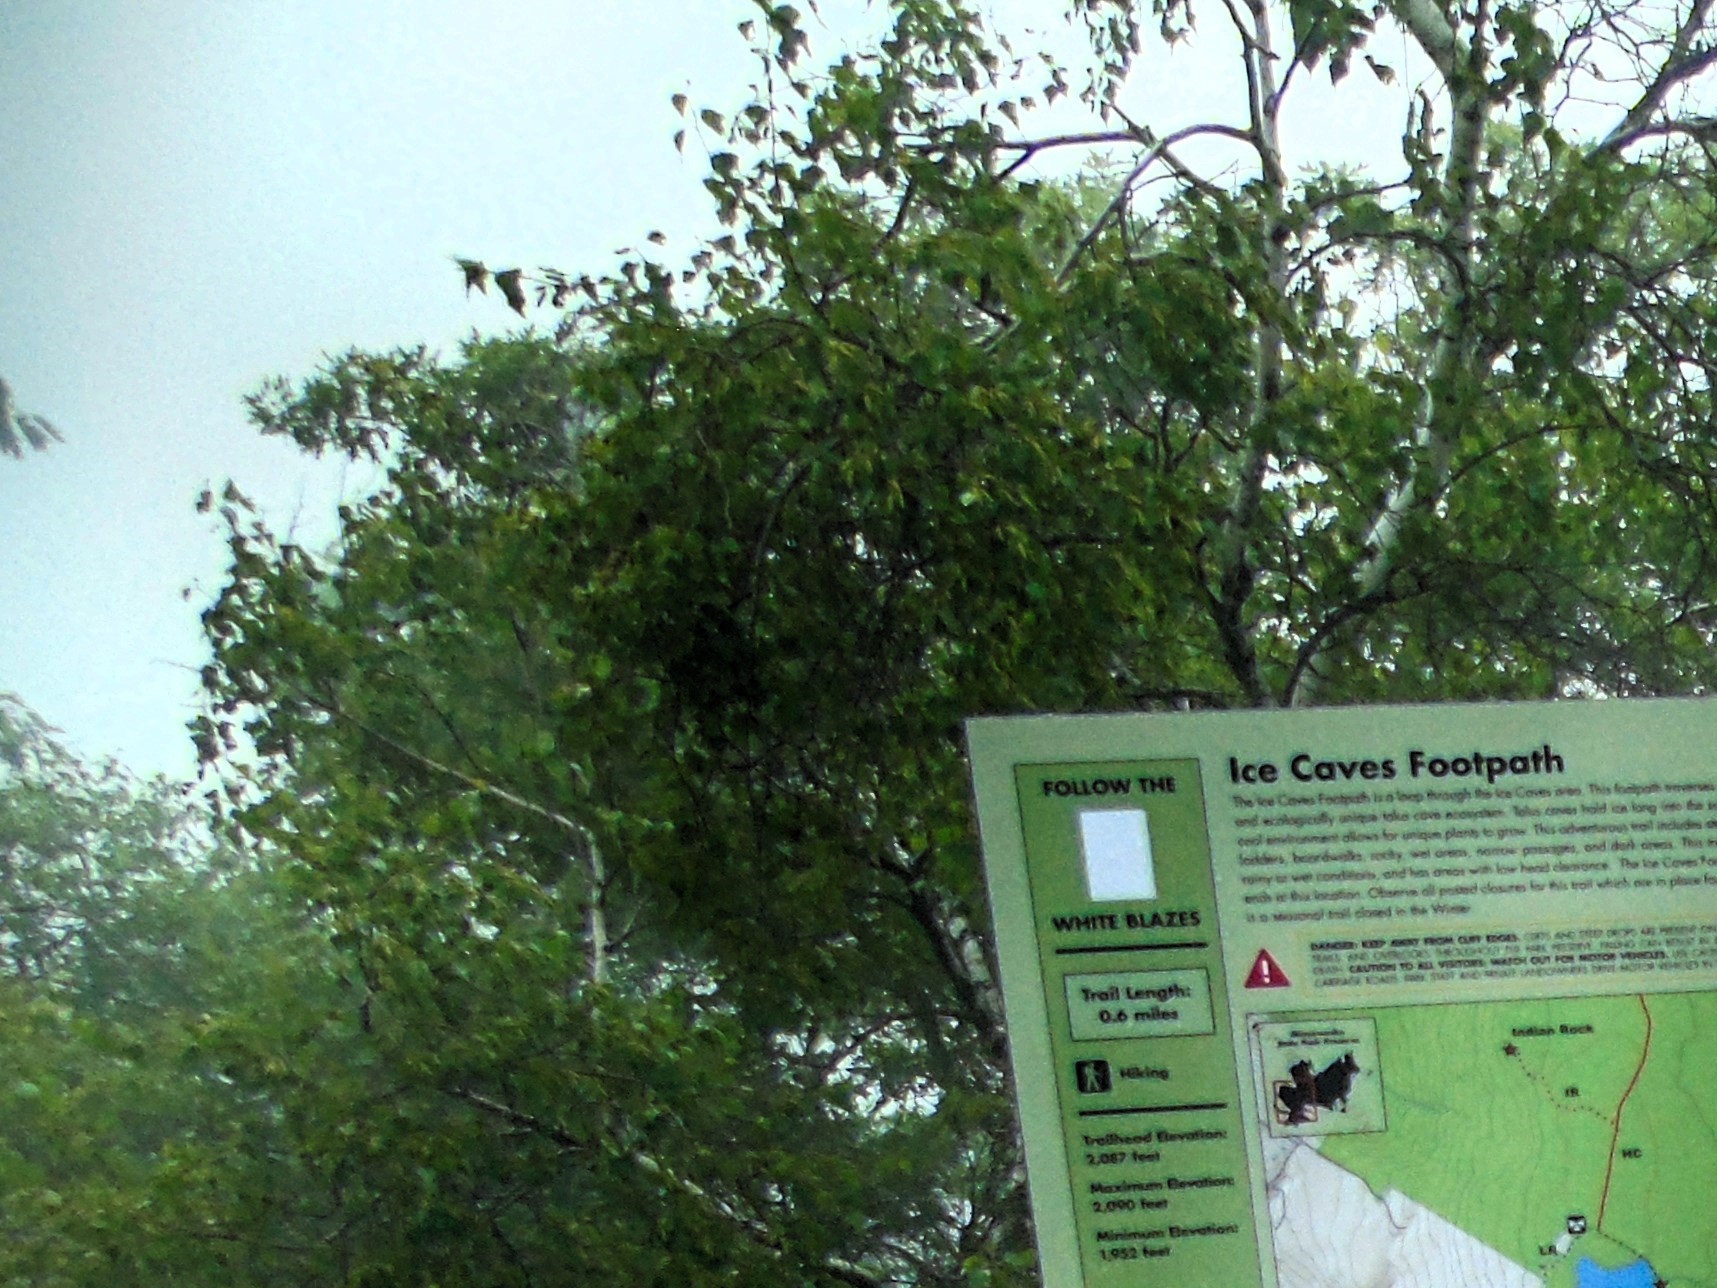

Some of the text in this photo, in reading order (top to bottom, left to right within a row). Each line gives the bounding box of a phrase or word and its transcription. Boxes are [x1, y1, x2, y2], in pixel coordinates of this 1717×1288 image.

[1228, 744, 1564, 784] Ice Caves Footpath
[1042, 776, 1176, 797] FOLLOW THE
[1051, 910, 1200, 931] WHITE BLAZES
[1081, 983, 1191, 1003] Trail Length:
[1098, 1005, 1178, 1023] 0.6 miles
[1511, 1023, 1593, 1037] Indian Rock
[1119, 1065, 1170, 1083] Hiking
[1083, 1127, 1227, 1146] Trailhead Elevation:
[1090, 1174, 1234, 1194] Maximum Elevation:
[1096, 1222, 1238, 1242] Minimum Elevation:
